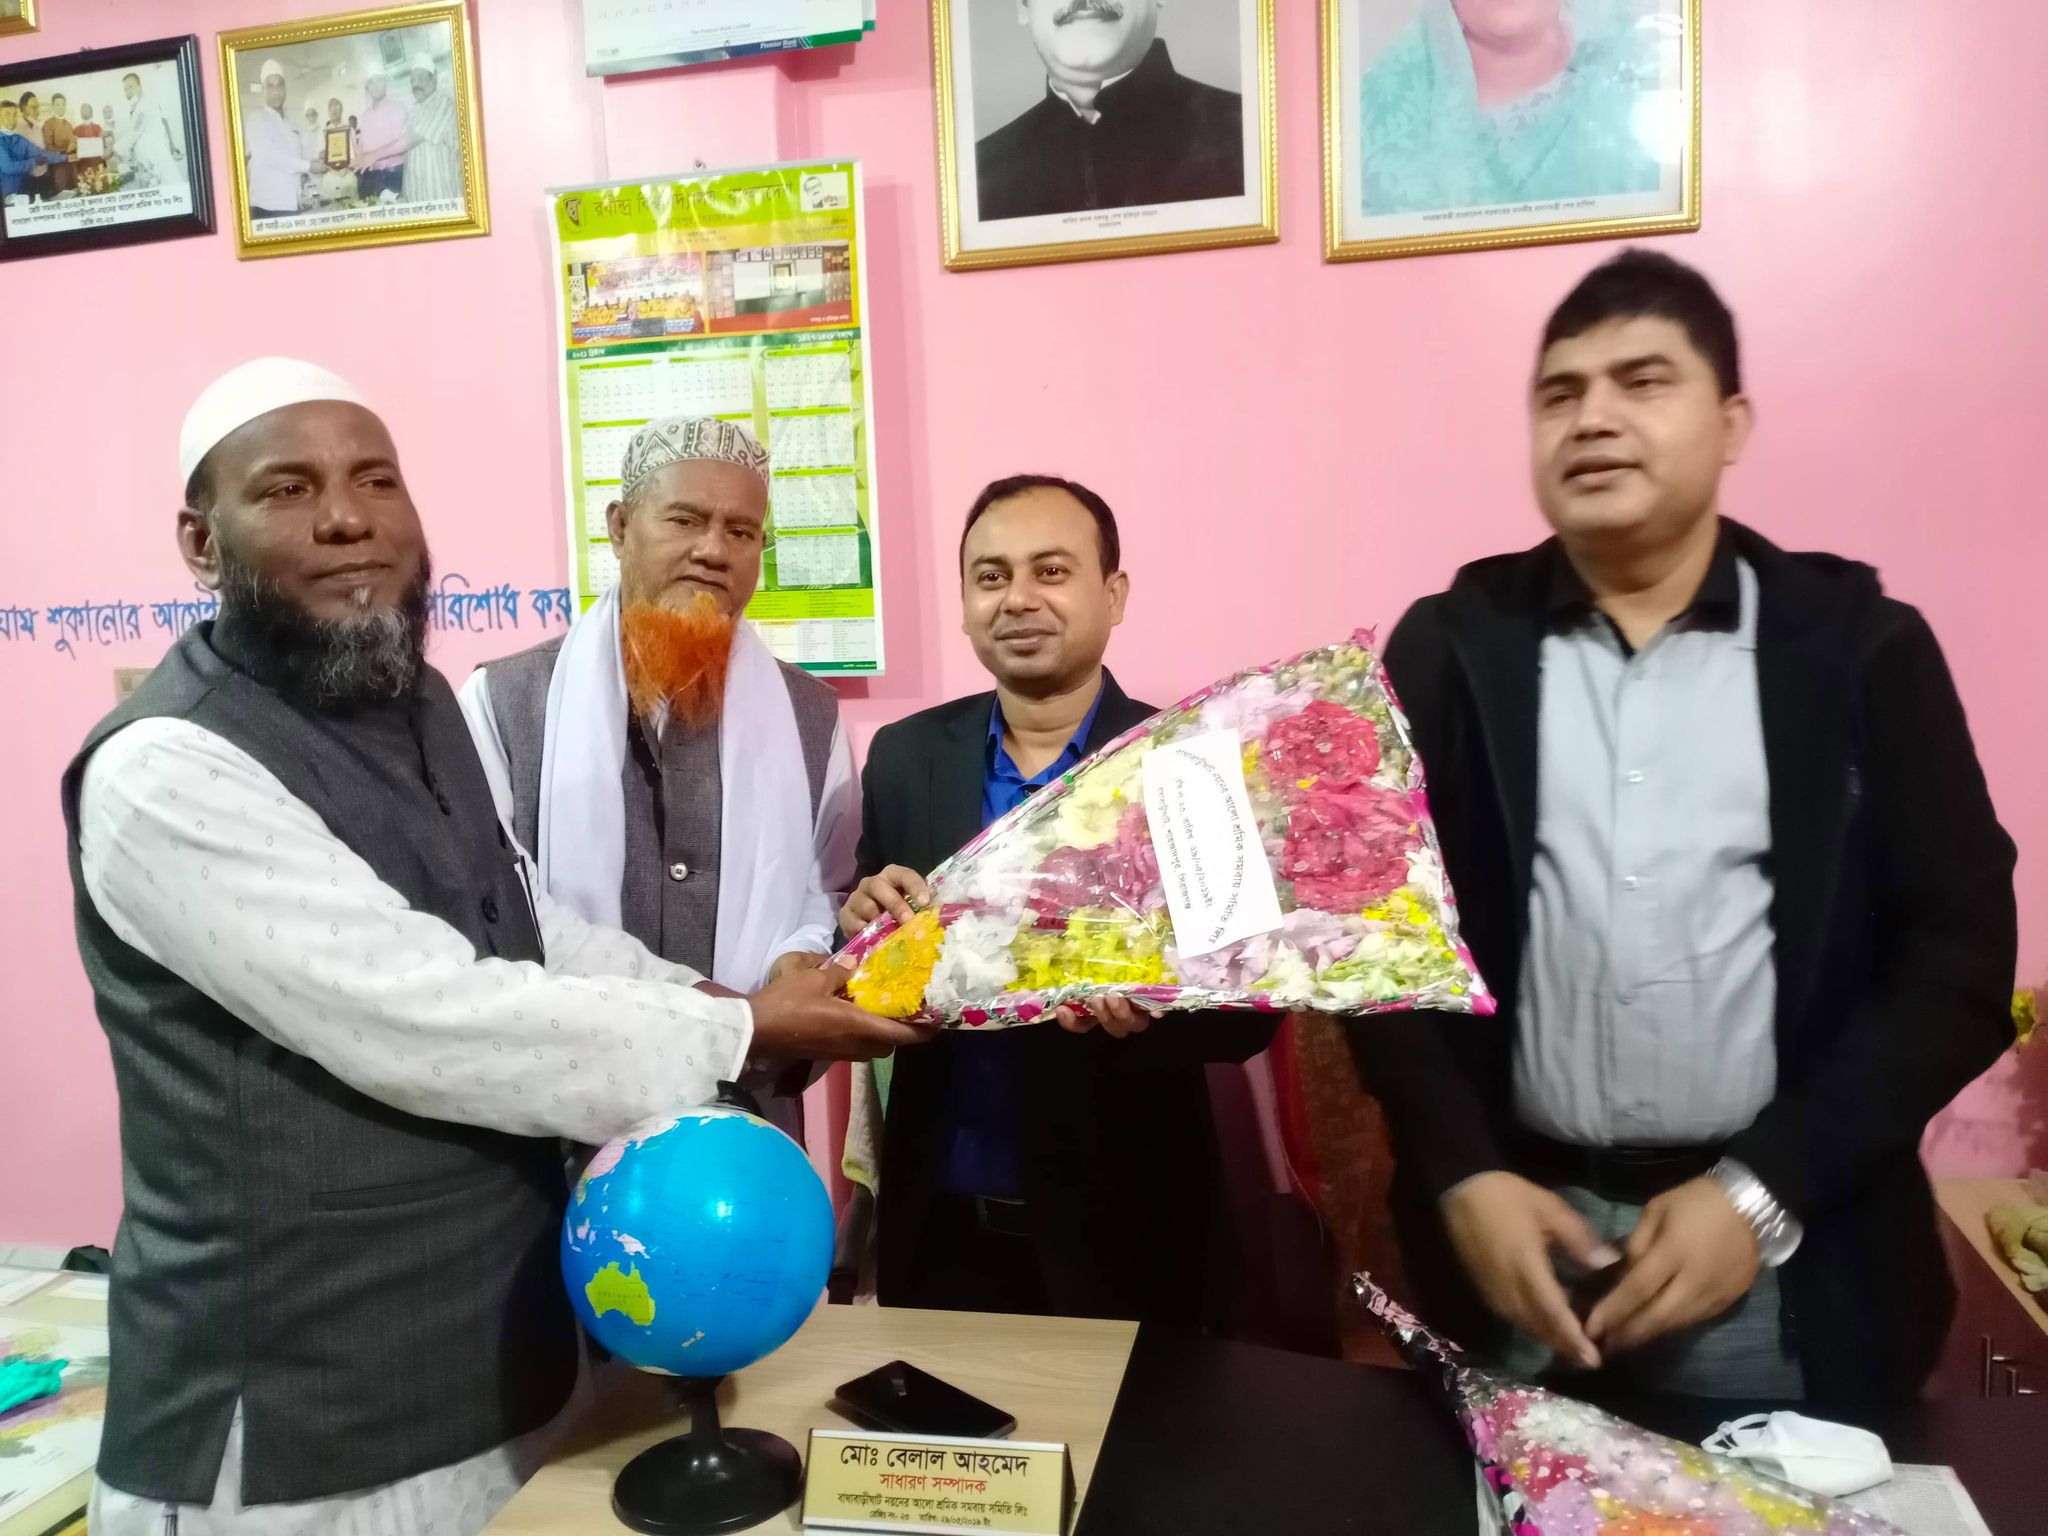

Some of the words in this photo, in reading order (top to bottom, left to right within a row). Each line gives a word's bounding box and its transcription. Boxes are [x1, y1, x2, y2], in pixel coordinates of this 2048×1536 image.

[760, 41, 782, 49] Premier
[782, 38, 798, 47] Bank
[592, 192, 632, 216] রবীন্দ্র
[47, 600, 143, 660] শুকানোর
[1224, 794, 1240, 821] আলো
[1231, 823, 1246, 851] শ্রমিক
[1231, 855, 1245, 889] সমবায়
[1177, 873, 1192, 910] সিরাজগঞ্জ
[1219, 892, 1239, 924] সমিতি
[1207, 926, 1226, 945] লিঃ
[841, 1444, 879, 1467] মোঃ
[887, 1446, 947, 1471] বেলাল
[953, 1451, 1030, 1477] আহমেদ
[879, 1473, 926, 1491] সাধারণ
[931, 1477, 988, 1495] সম্পাদক
[884, 1497, 910, 1508] নয়নের
[912, 1498, 935, 1509] আলো
[936, 1497, 958, 1511] শ্রমিক
[960, 1502, 986, 1513] সমবায়
[988, 1500, 1012, 1515] সমিতি
[1014, 1502, 1028, 1516] লিঃ
